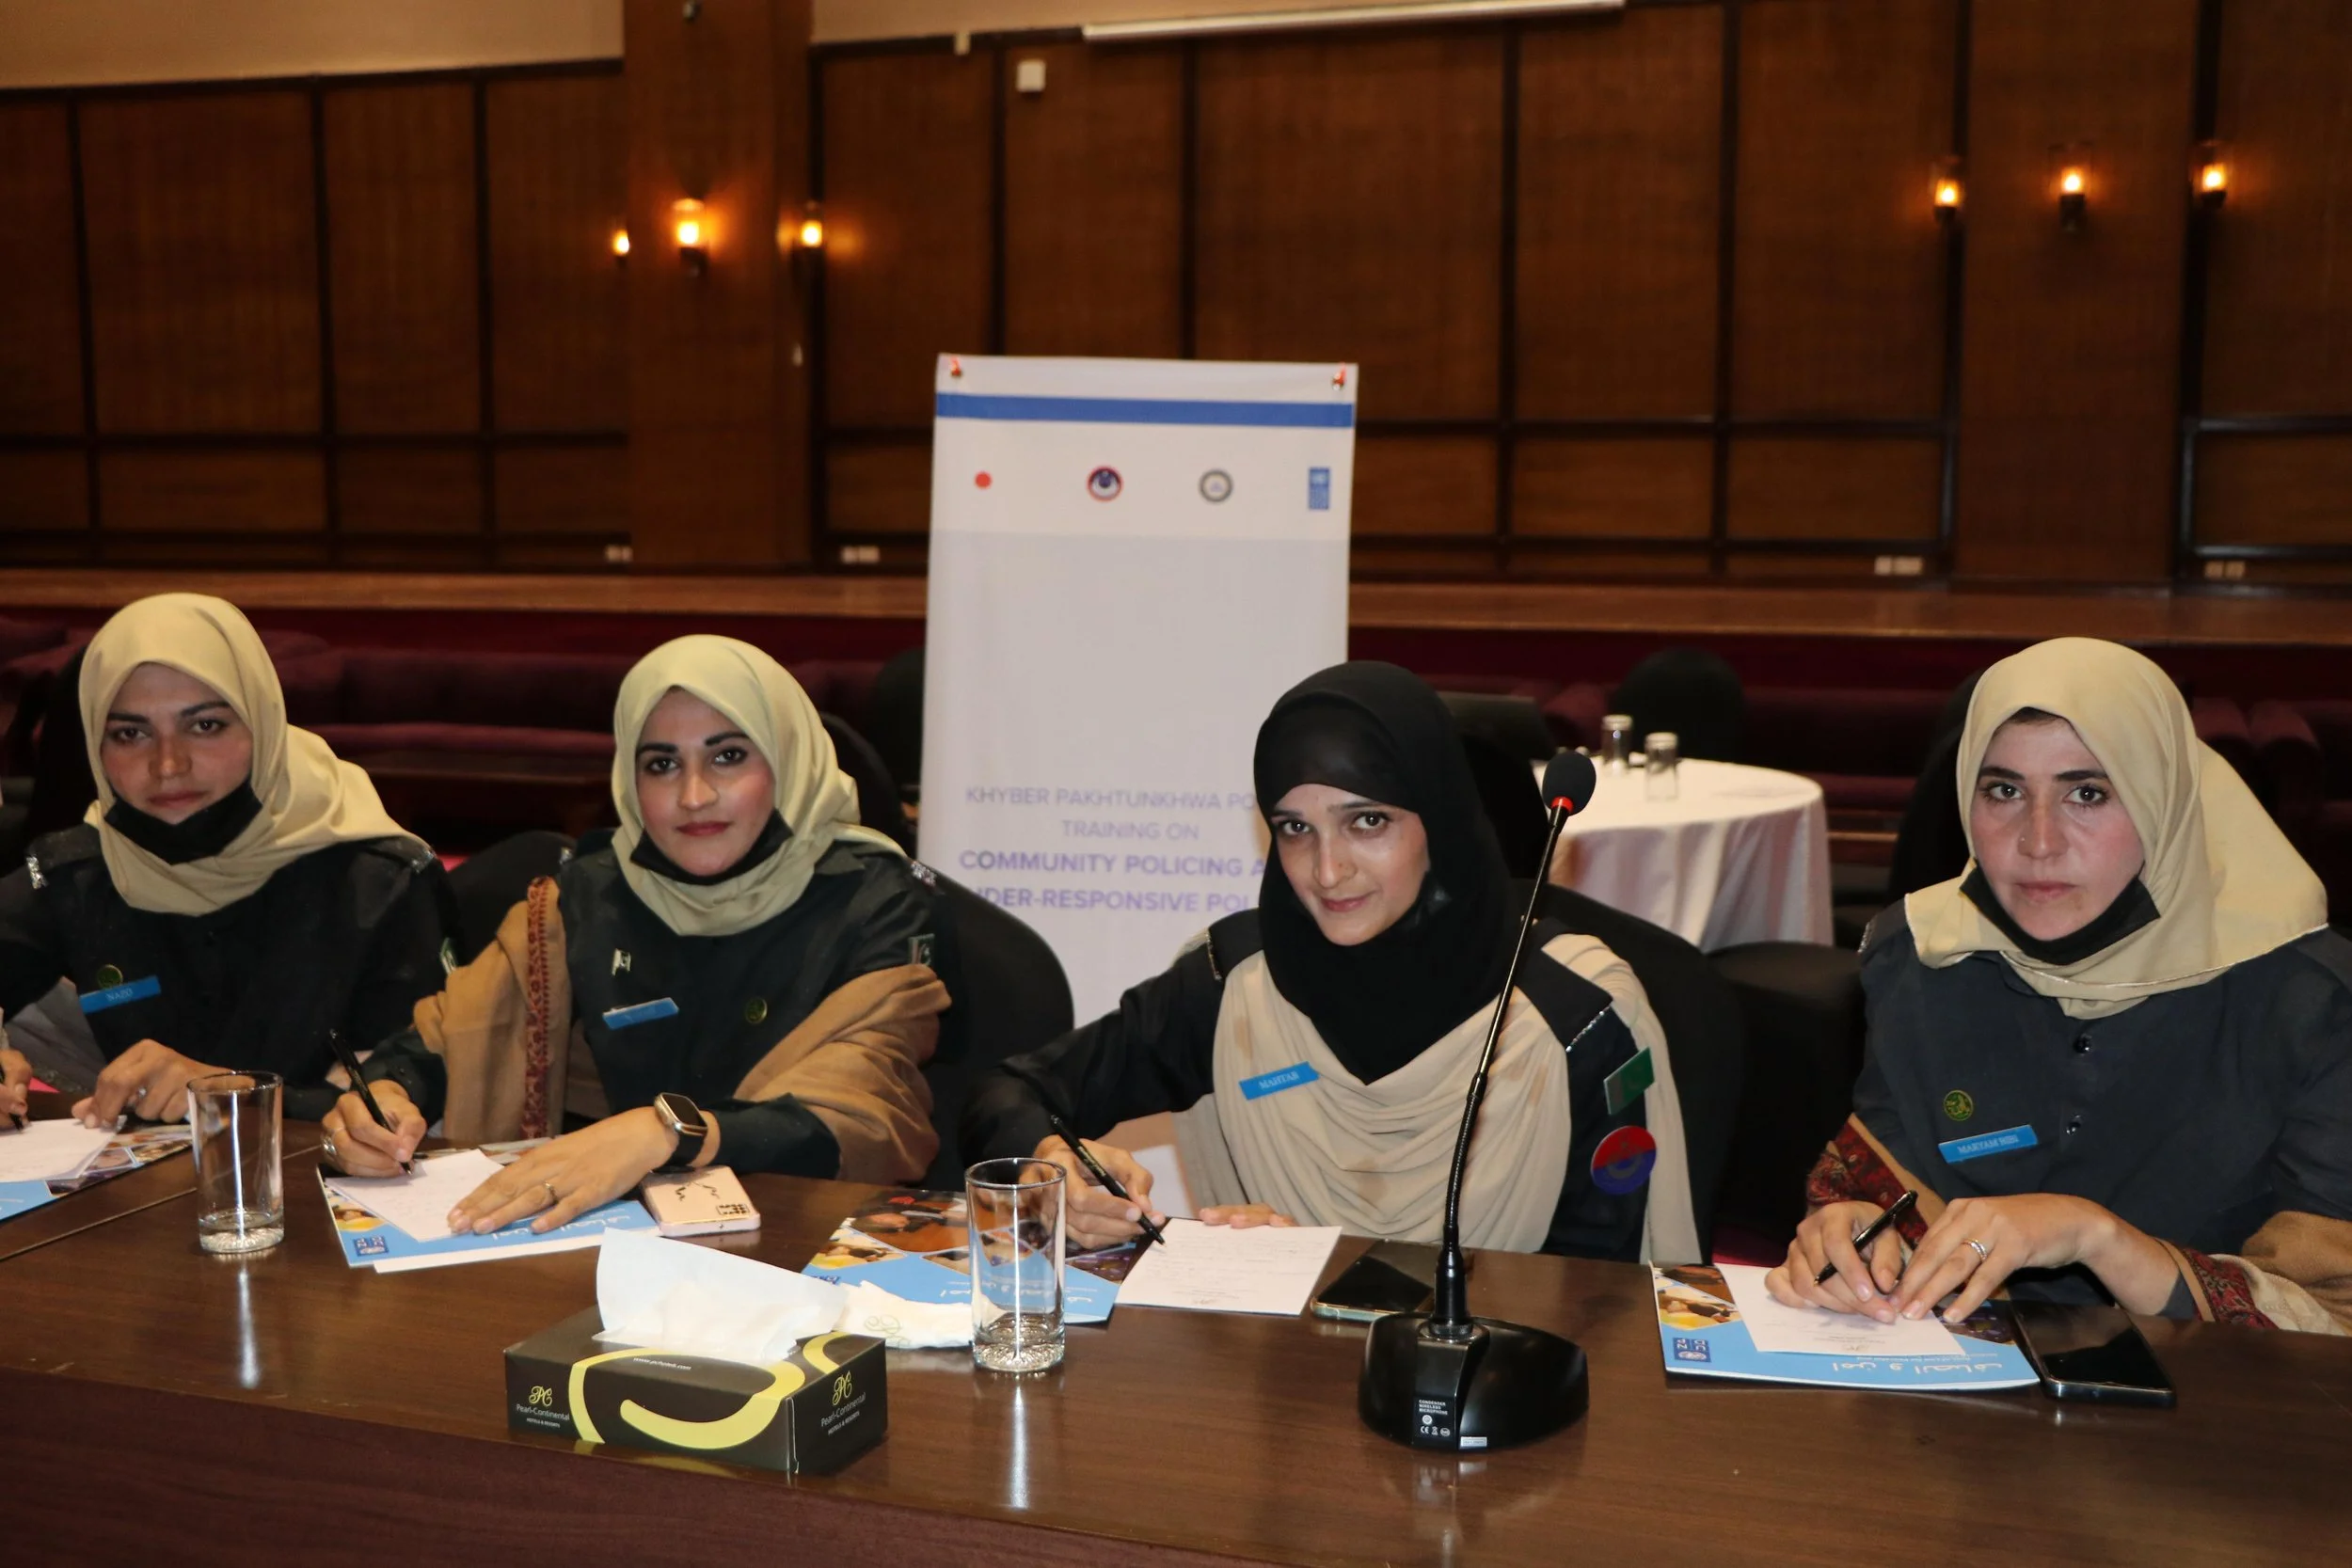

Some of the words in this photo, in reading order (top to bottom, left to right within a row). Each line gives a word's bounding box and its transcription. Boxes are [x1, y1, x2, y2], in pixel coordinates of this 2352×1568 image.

[965, 786, 1050, 805] KHYBER
[1057, 787, 1222, 810] PAKHTUNKHWA
[1227, 792, 1255, 812] PO
[1062, 819, 1162, 839] TRAINING
[1166, 823, 1200, 841] ON
[959, 850, 1117, 873] COMMUNITY
[1124, 854, 1243, 878] POLICING
[1250, 858, 1265, 877] A
[978, 888, 1200, 912] DER-RESPONSIVE
[516, 1403, 570, 1421] Pearl-Continental
[820, 1391, 866, 1428] Pearl-Continental
